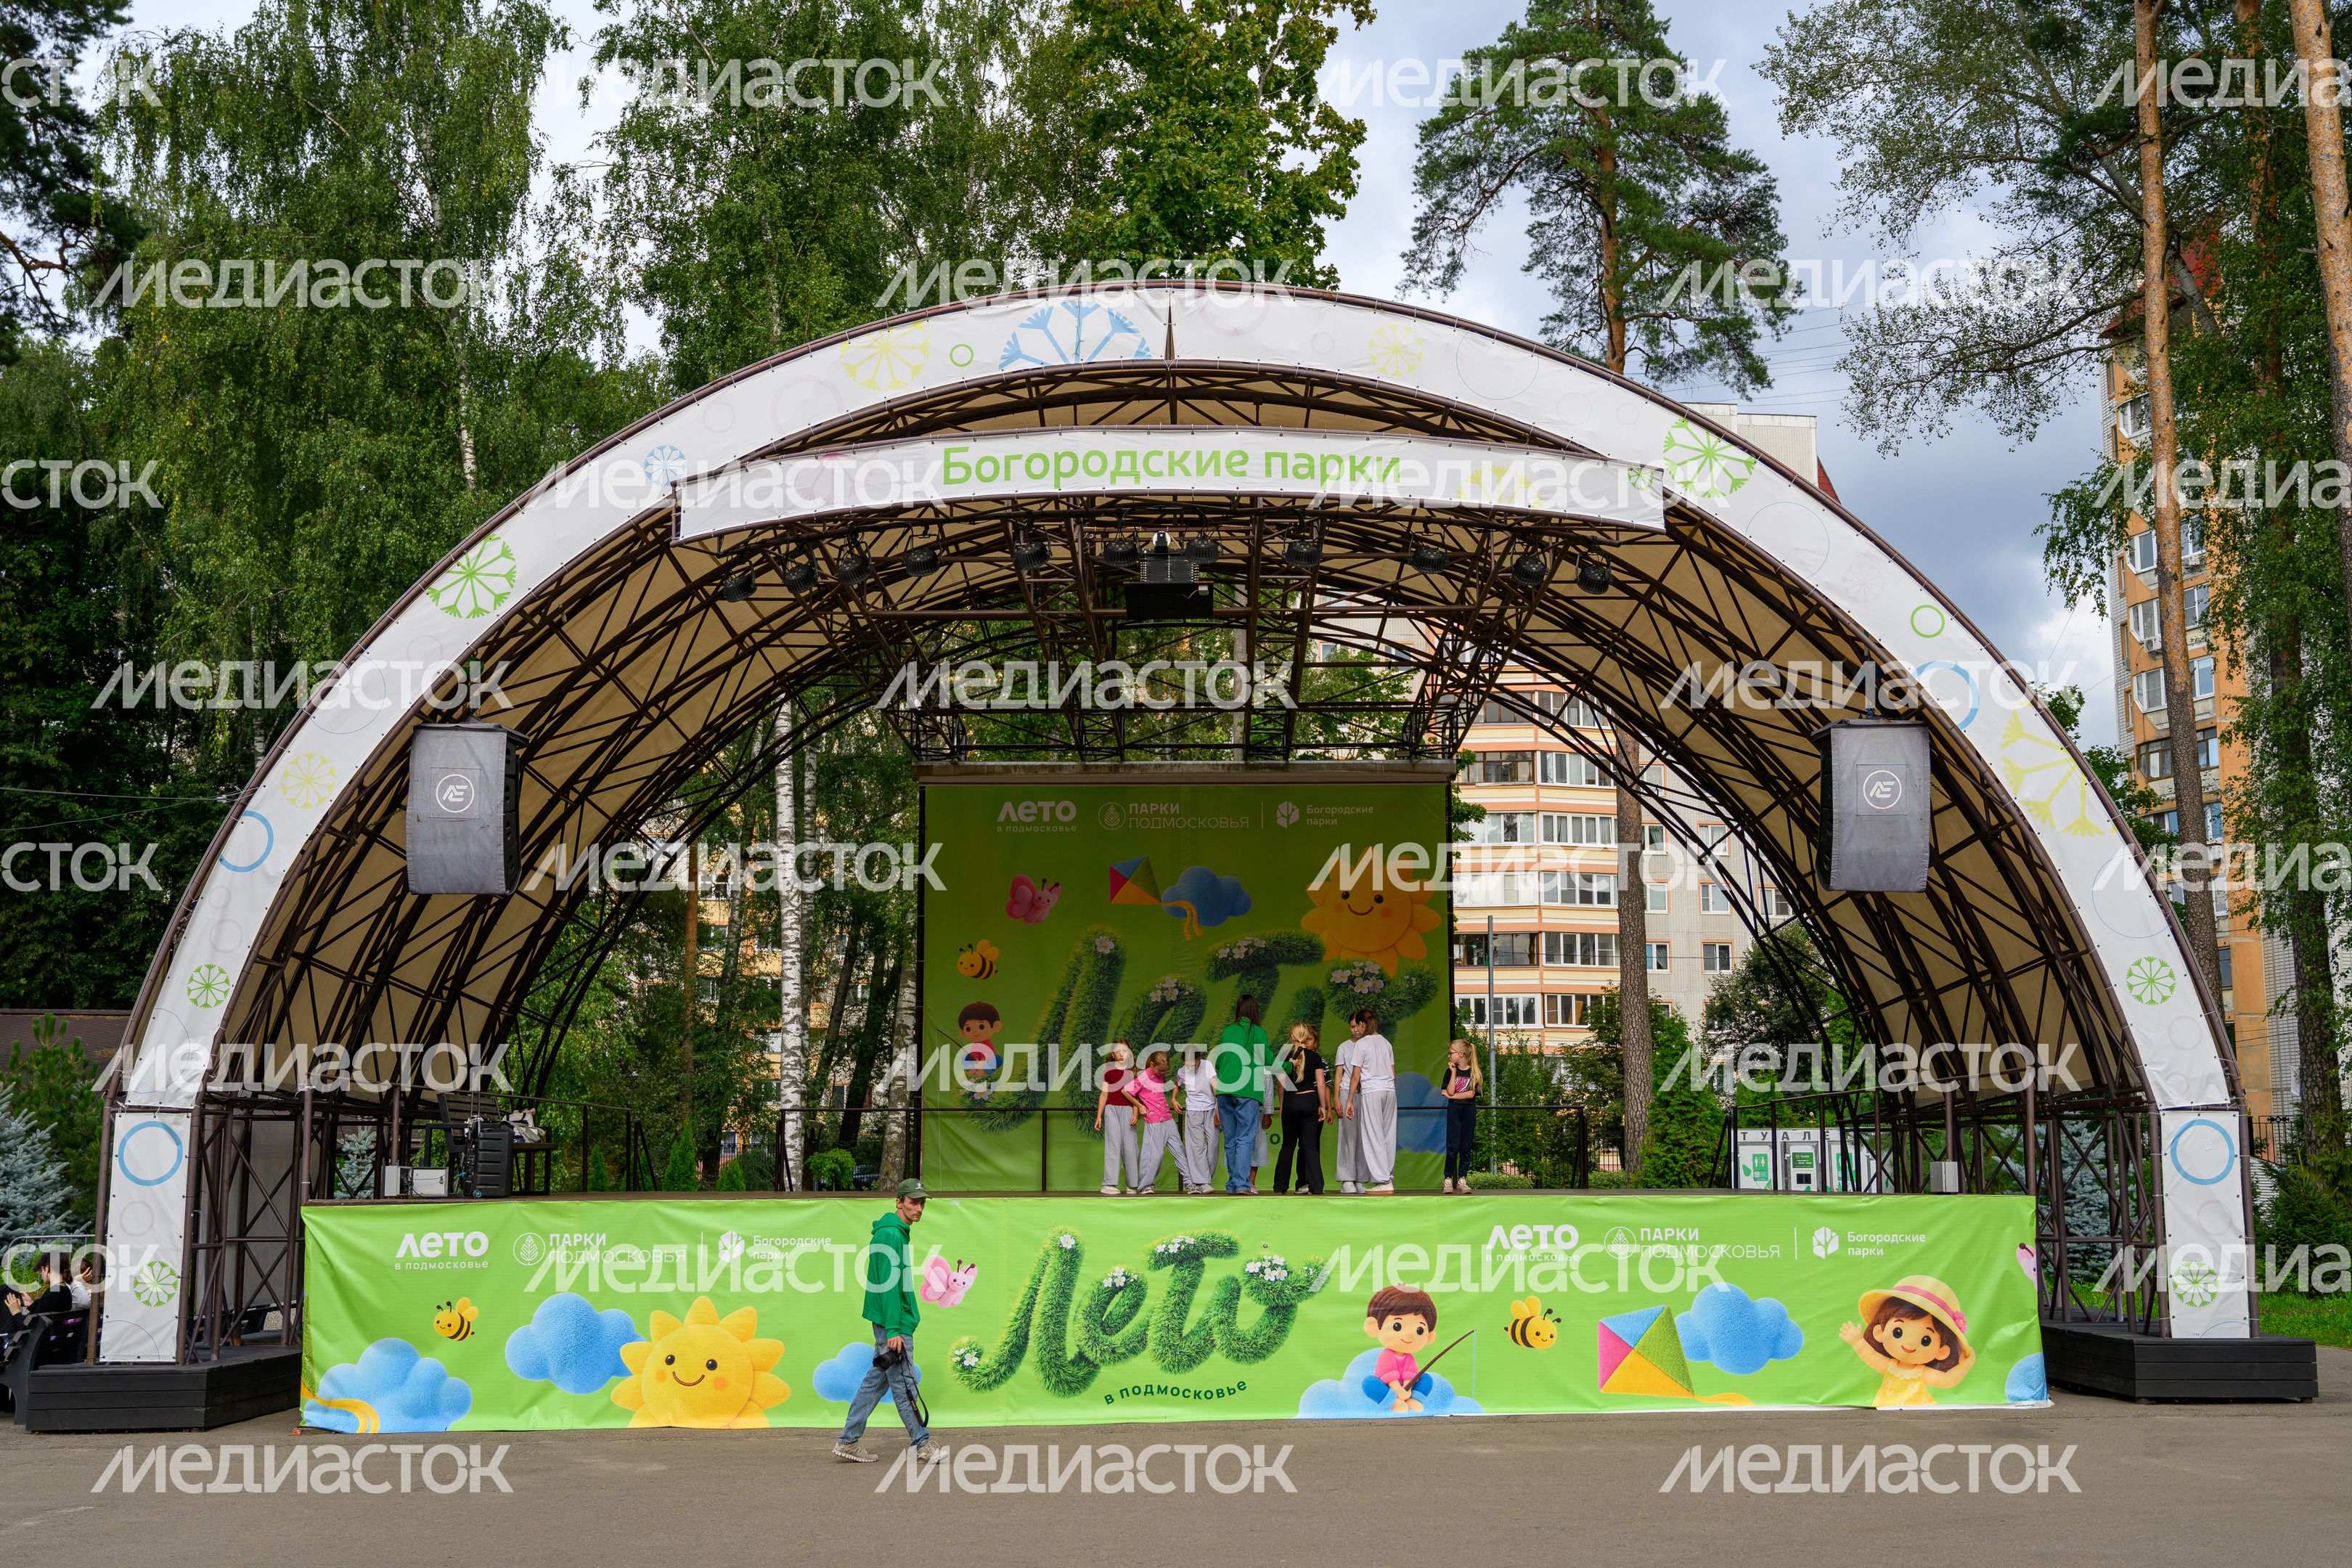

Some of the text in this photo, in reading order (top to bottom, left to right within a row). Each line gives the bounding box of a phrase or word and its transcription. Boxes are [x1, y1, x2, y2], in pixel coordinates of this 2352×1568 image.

[943, 446, 1400, 489] Богородские парки
[1129, 803, 1180, 814] ПАРКИ
[1307, 804, 1374, 816] Богородские
[1129, 816, 1249, 829] ПОДМОСКОВЬЯ
[1307, 817, 1338, 827] парки
[550, 1233, 607, 1246] ПАРКИ
[1640, 1228, 1699, 1241] ПАРКИ
[1847, 1231, 1926, 1244] Богородские
[753, 1236, 832, 1247] Богородские
[549, 1249, 686, 1264] ПОДМОСКОВЬЯ
[753, 1251, 789, 1261] парки
[1497, 1254, 1580, 1262] подмосковье
[1640, 1245, 1780, 1259] ПОДМОСКОВЬЯ
[1847, 1247, 1884, 1257] парки
[407, 1261, 489, 1270] подмосковье
[1103, 1379, 1248, 1405] в подмосковье
